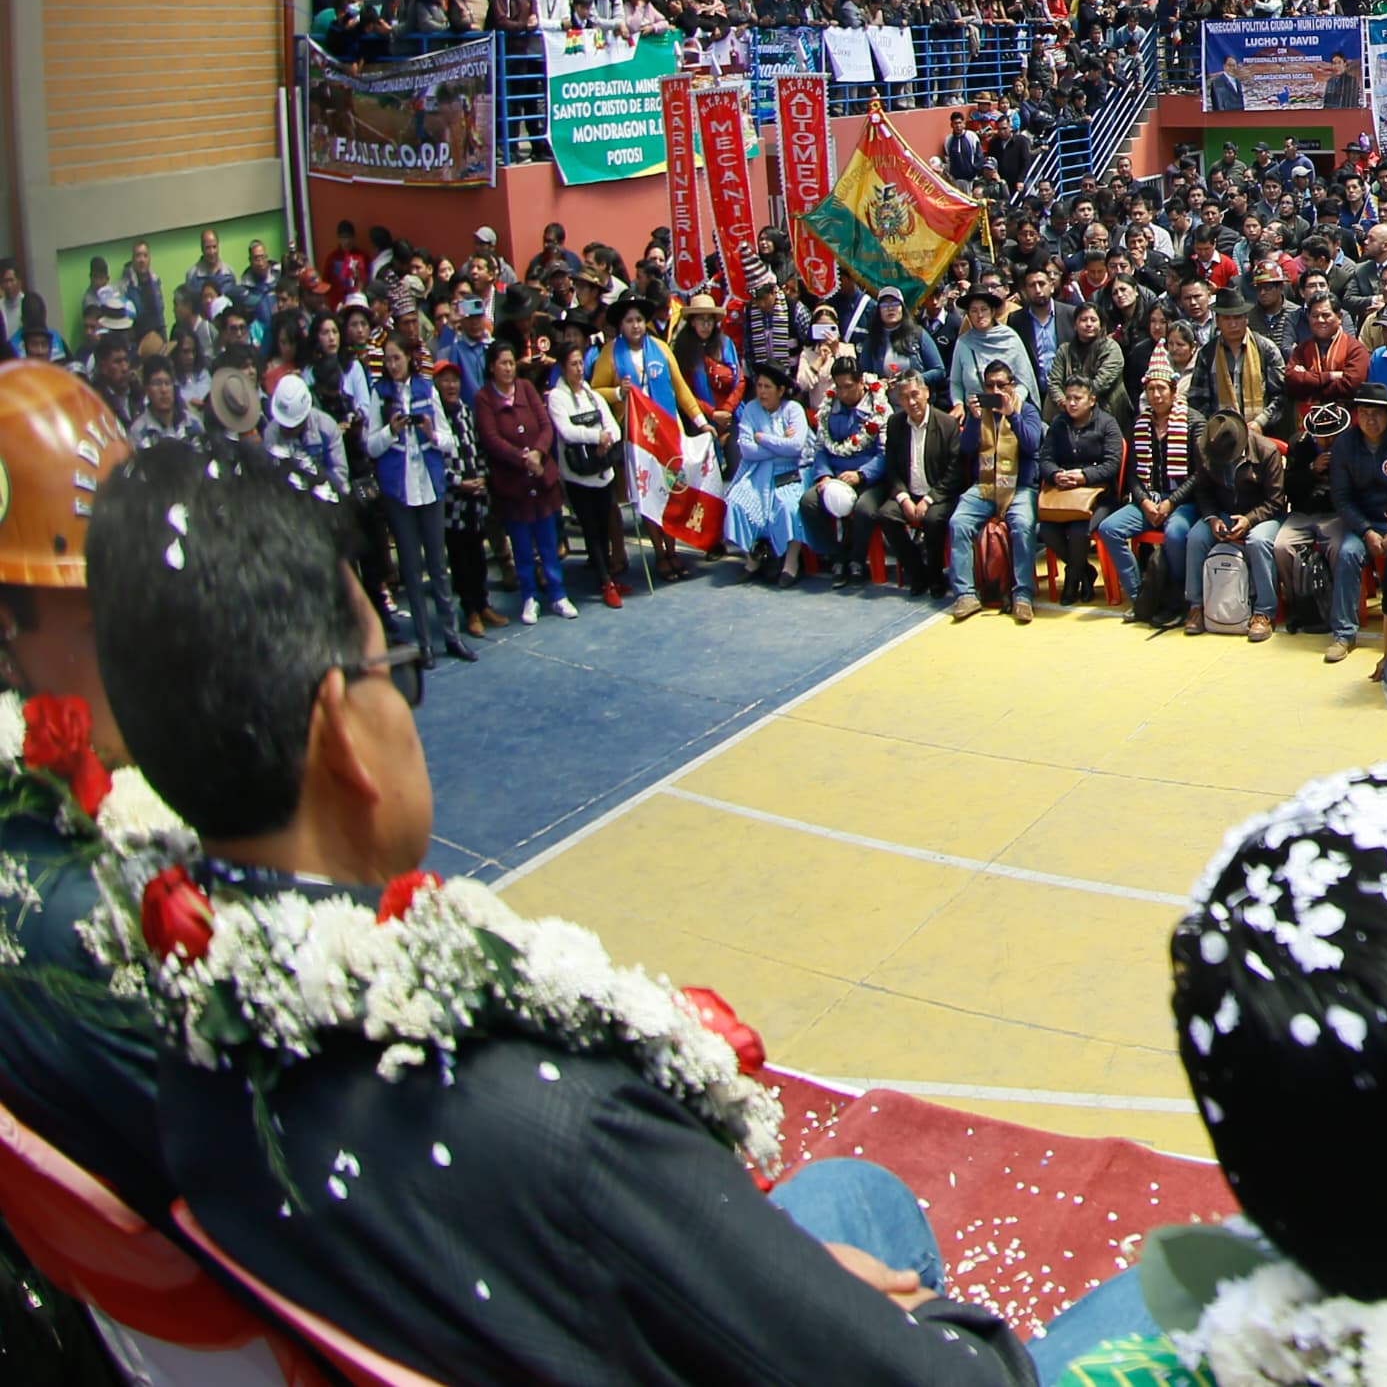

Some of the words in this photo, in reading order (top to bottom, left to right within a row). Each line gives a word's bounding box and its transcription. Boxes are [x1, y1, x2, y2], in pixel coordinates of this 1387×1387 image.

[1270, 20, 1293, 32] CIUDAD
[1245, 37, 1278, 47] LUCHO
[1280, 36, 1288, 46] Y
[1289, 35, 1319, 46] DAVID
[562, 80, 633, 99] COOPERATIVA
[635, 78, 659, 93] MINE
[553, 101, 591, 120] SANTO
[594, 99, 628, 117] CRISTO
[630, 98, 641, 113] DE
[573, 122, 647, 143] MONDRAGON
[607, 147, 643, 166] POTOSI
[669, 101, 693, 263] CARPINTERIA
[789, 92, 828, 293] AUTOMECICA
